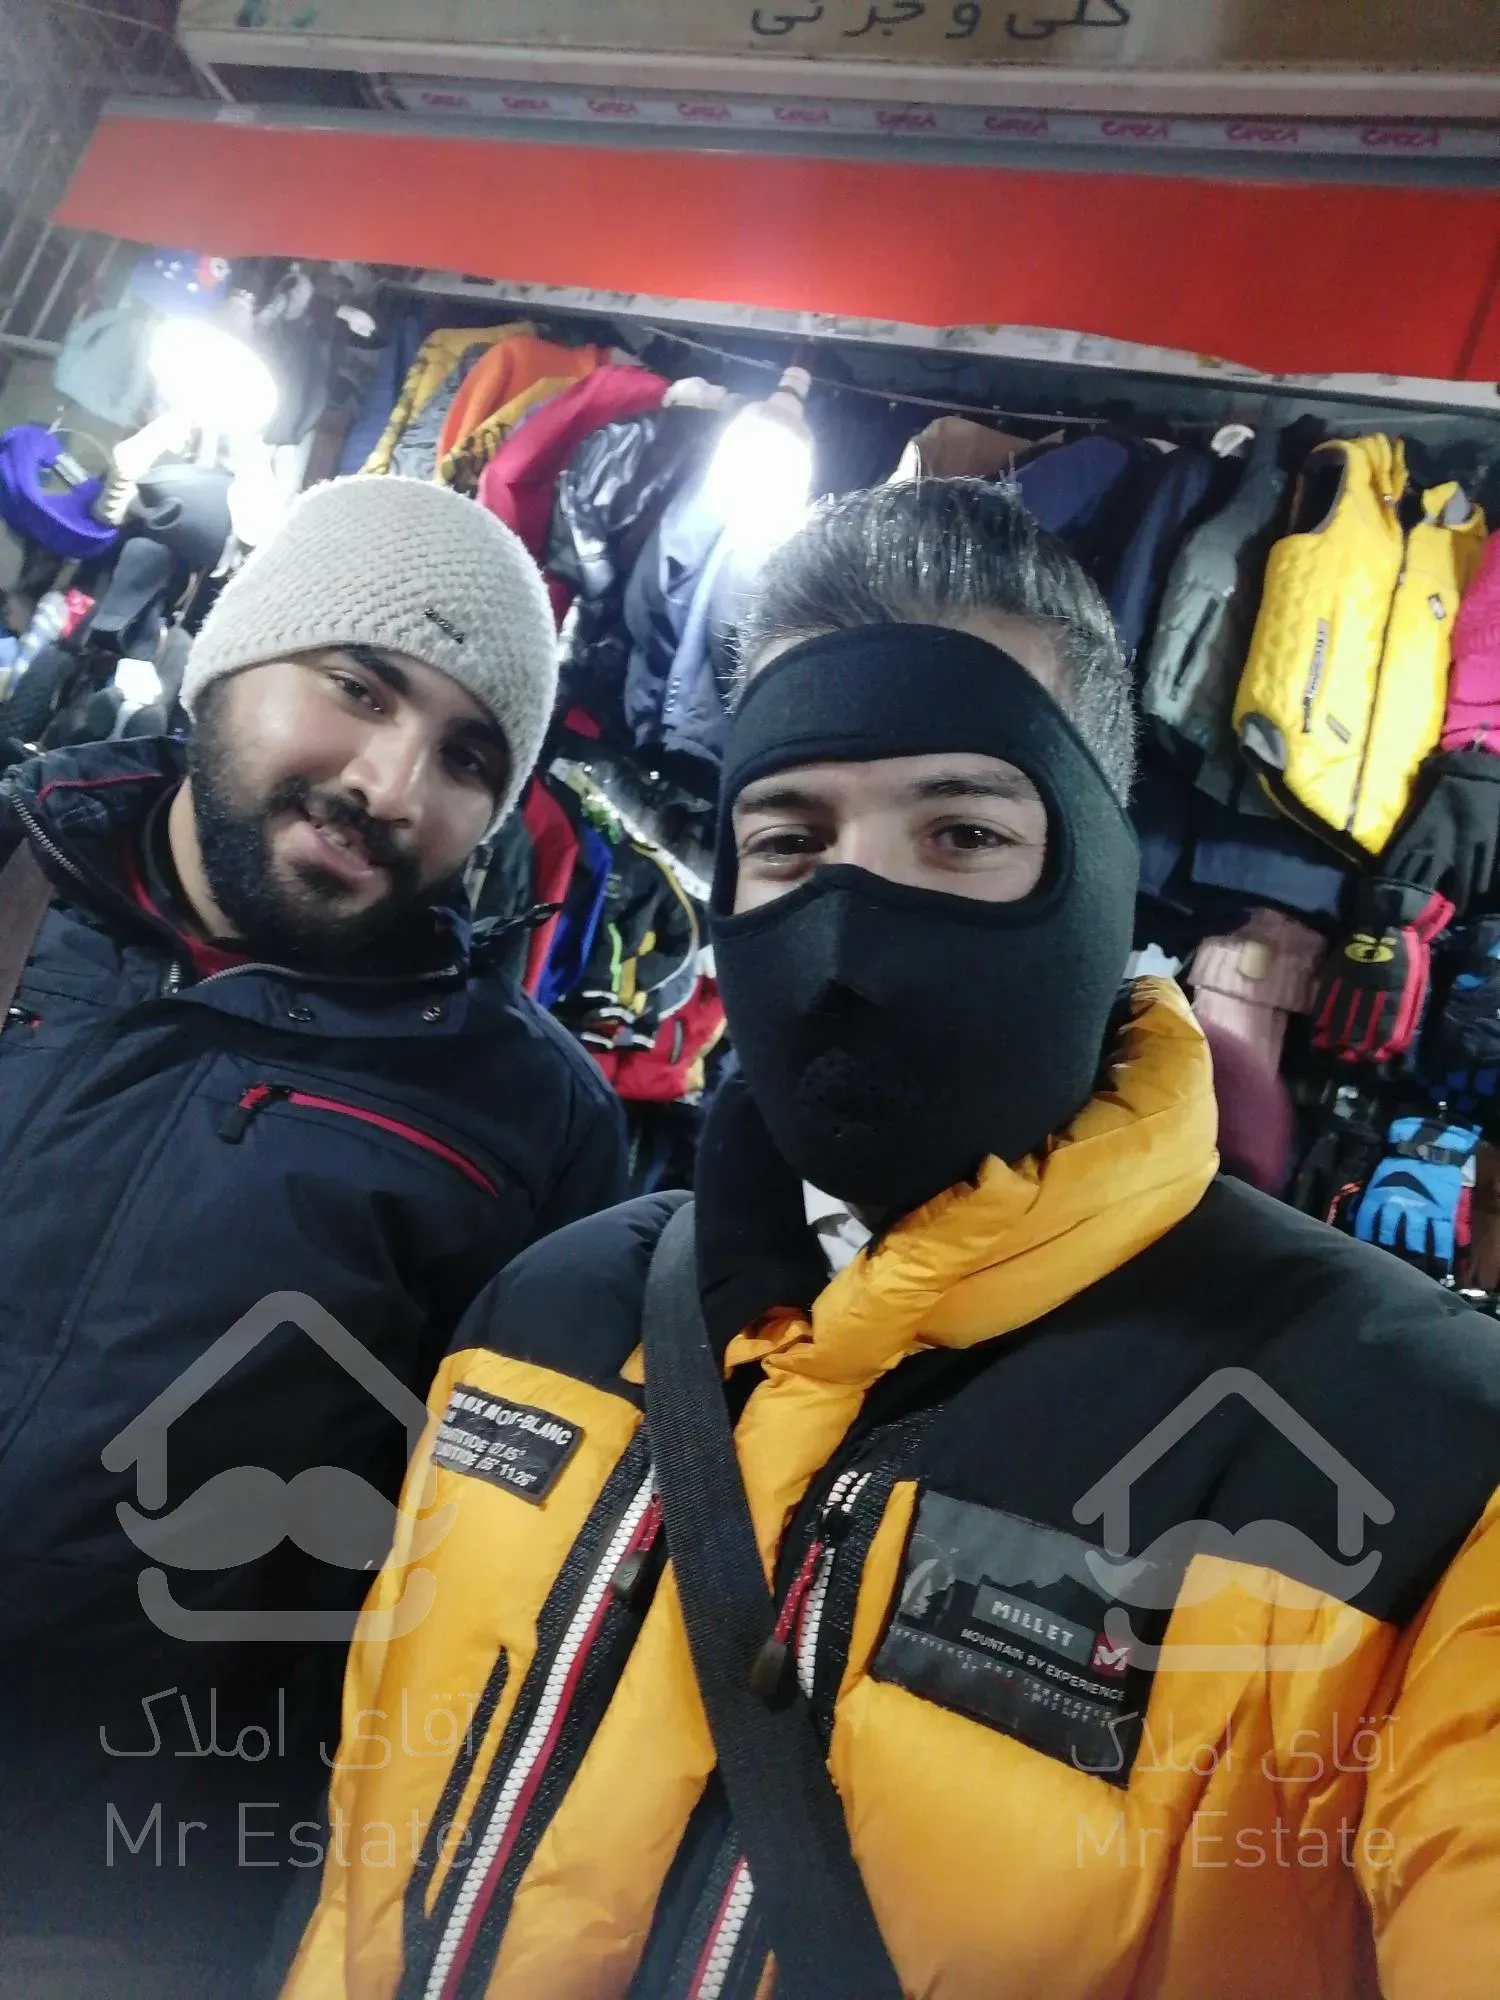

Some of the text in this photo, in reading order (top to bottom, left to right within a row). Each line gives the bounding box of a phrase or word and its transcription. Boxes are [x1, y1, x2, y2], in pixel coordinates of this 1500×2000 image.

[945, 1, 982, 39] و
[990, 1600, 1075, 1648] MILLET
[960, 1628, 1126, 1701] MOUNTAIN BY EXPERIENCE
